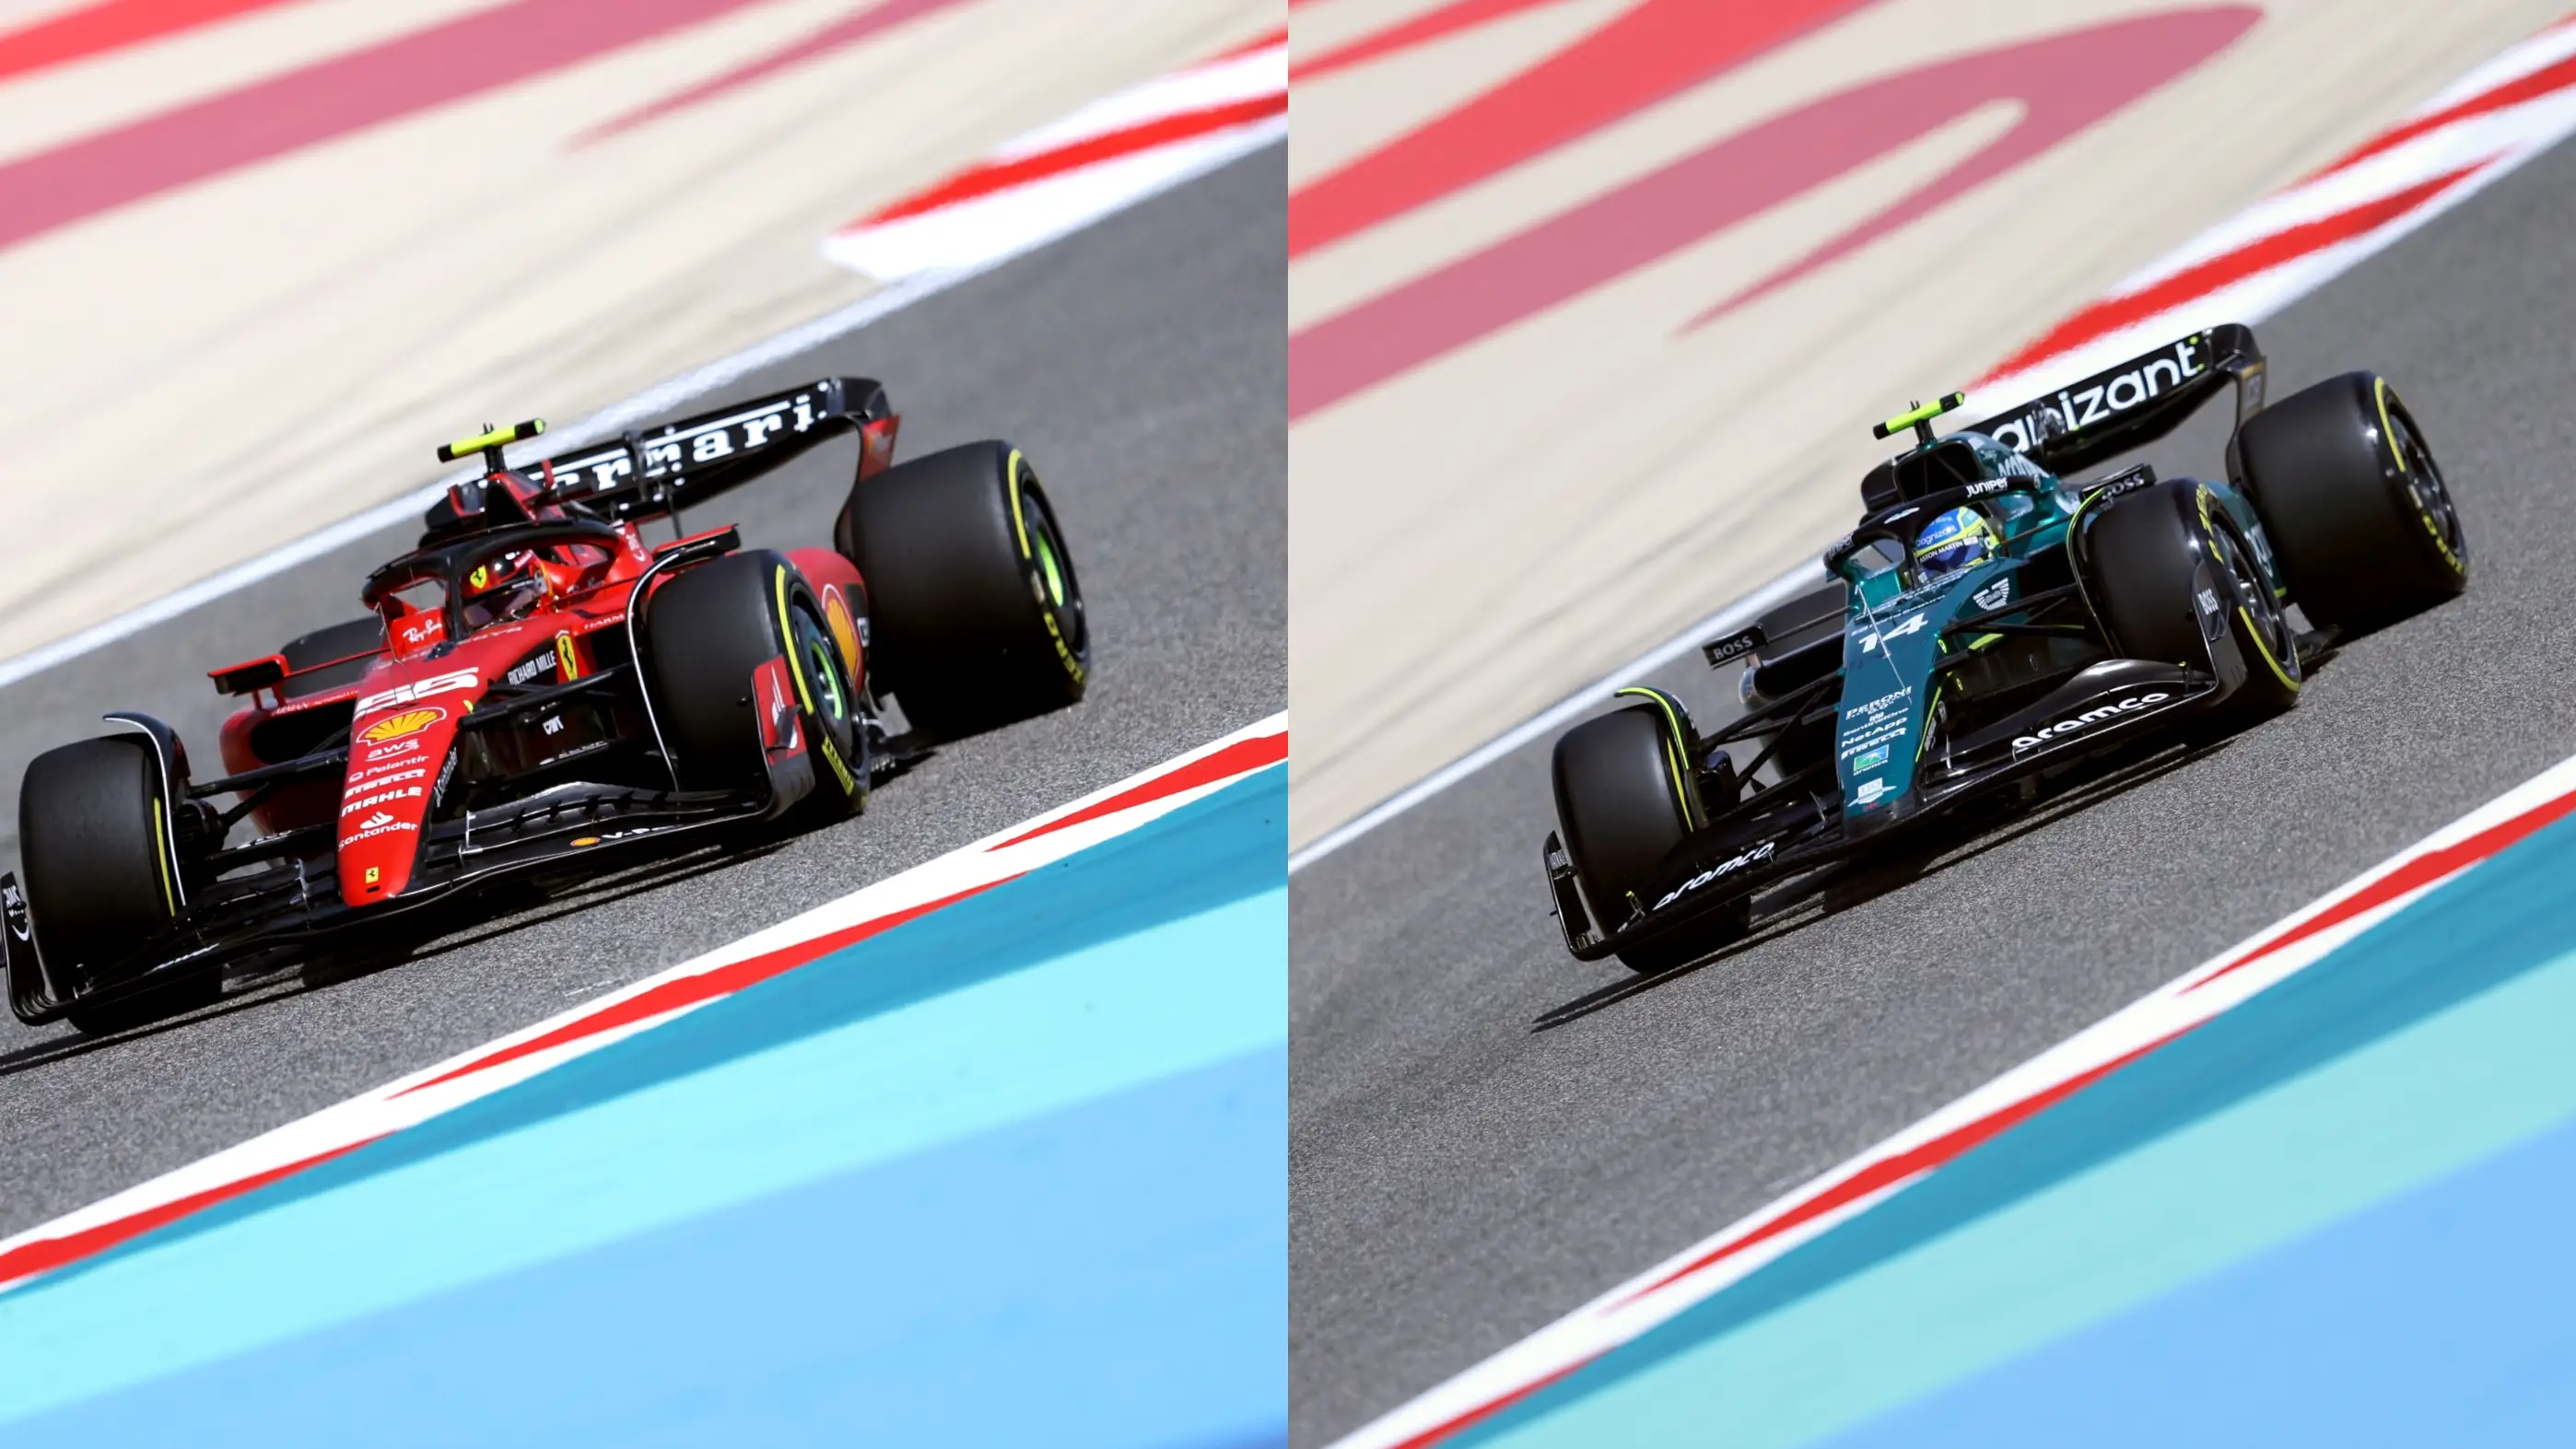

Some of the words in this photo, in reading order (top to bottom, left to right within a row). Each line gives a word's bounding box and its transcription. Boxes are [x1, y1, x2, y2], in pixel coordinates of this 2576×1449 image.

[1991, 342, 2200, 453] gnizant
[1938, 540, 1963, 555] MARTIN
[1714, 635, 1753, 660] BOSS
[1858, 612, 1928, 654] 14
[508, 659, 537, 685] RICHARD
[535, 649, 557, 673] MILLE
[1845, 685, 1913, 720] PERONI
[1842, 717, 1908, 748] NetApp
[2011, 691, 2170, 754] aramco
[368, 738, 420, 759] aws
[366, 755, 430, 777] Palantir
[341, 786, 423, 818] MAHLE
[1652, 841, 1775, 912] aramco
